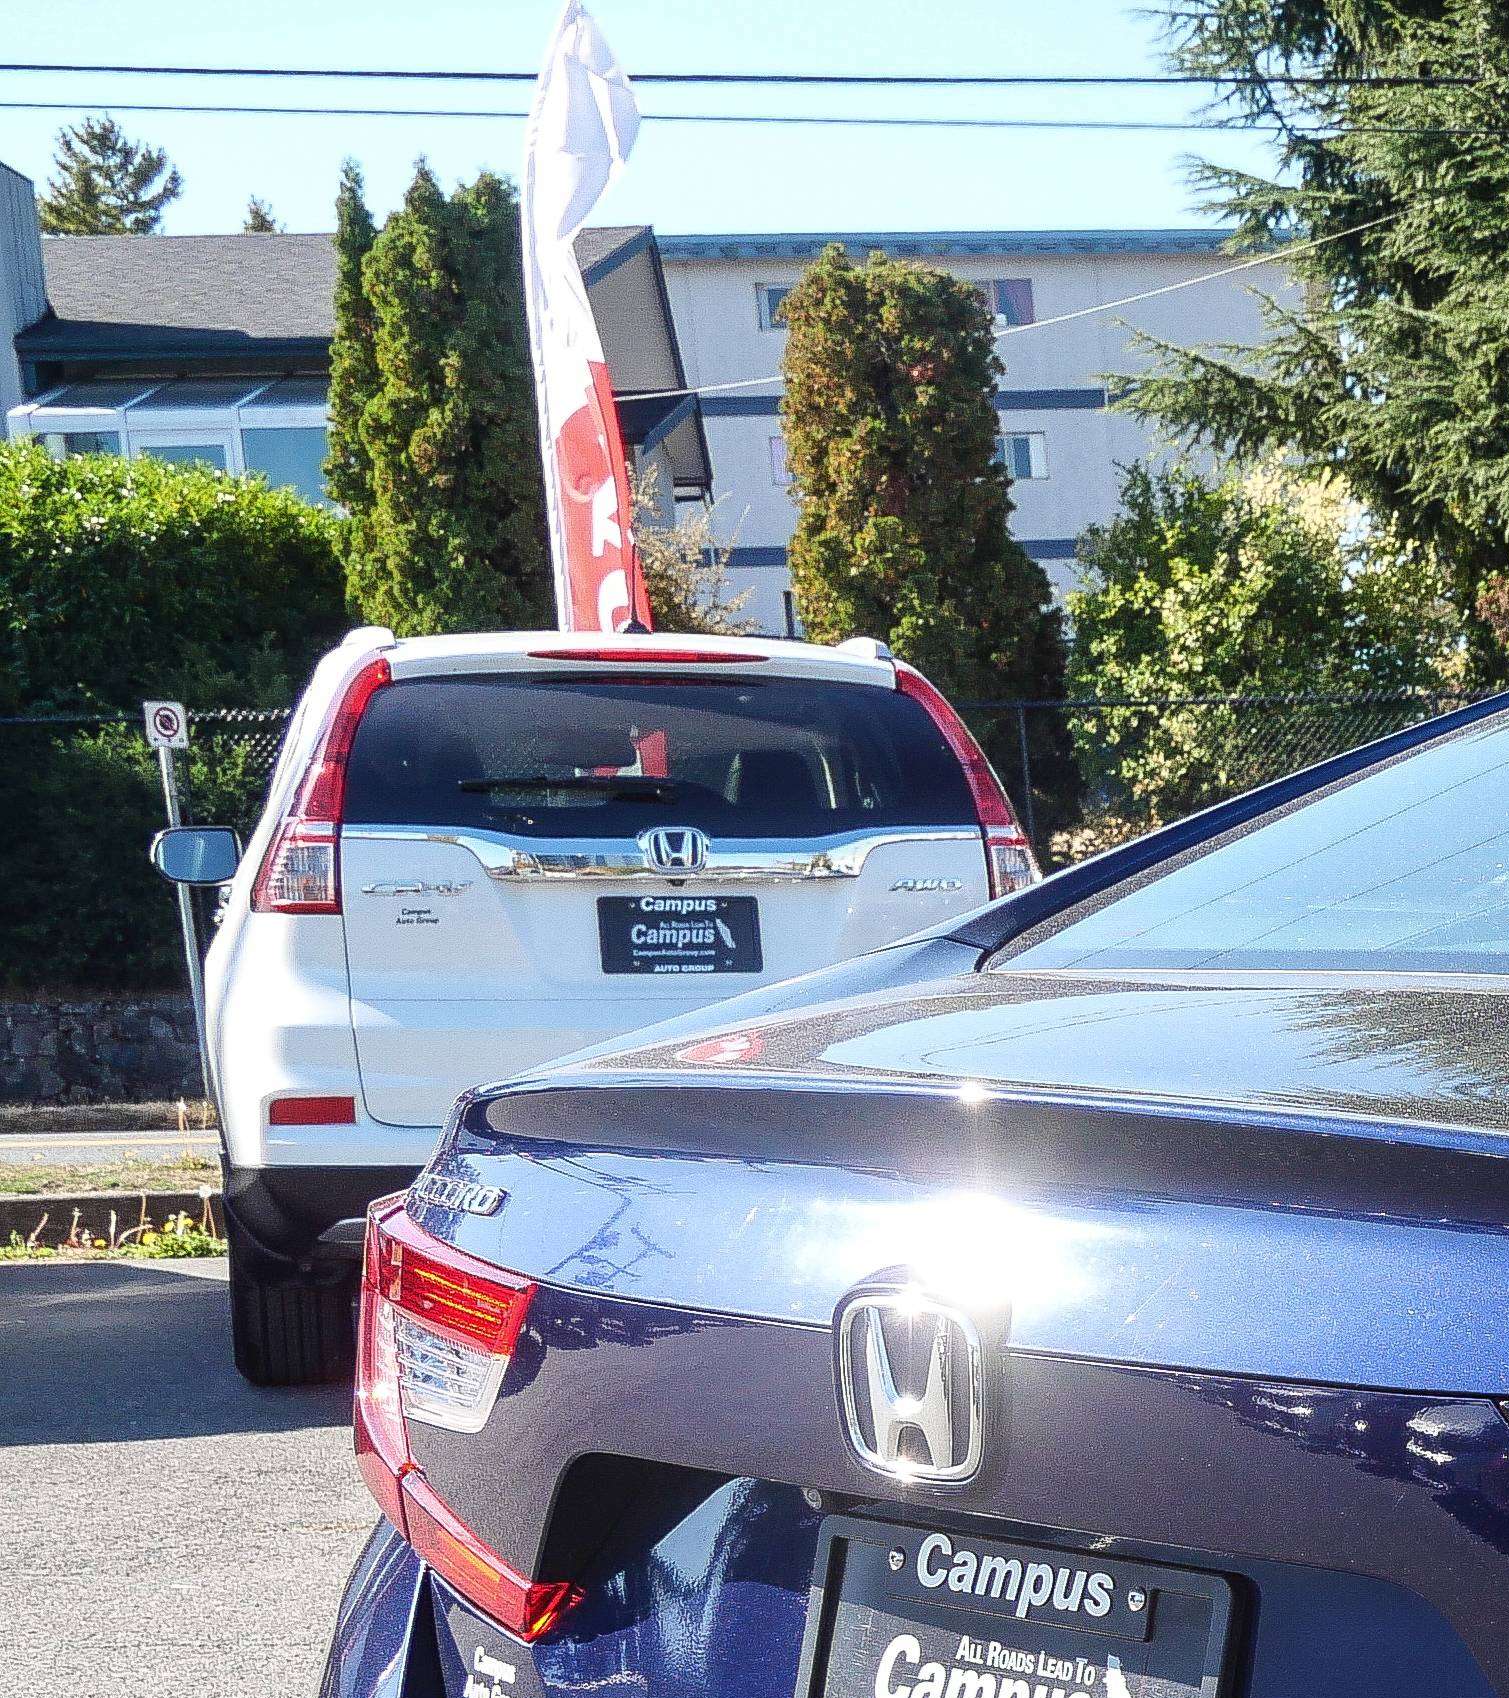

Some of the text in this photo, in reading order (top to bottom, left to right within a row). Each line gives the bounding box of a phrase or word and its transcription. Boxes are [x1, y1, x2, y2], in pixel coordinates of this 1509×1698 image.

[640, 897, 717, 914] Campus
[631, 924, 715, 948] Campus
[654, 964, 680, 972] AUTO
[917, 1533, 1114, 1618] Campus
[473, 1645, 516, 1684] Campus
[955, 1634, 1096, 1686] ALL ROADS LEAD TO
